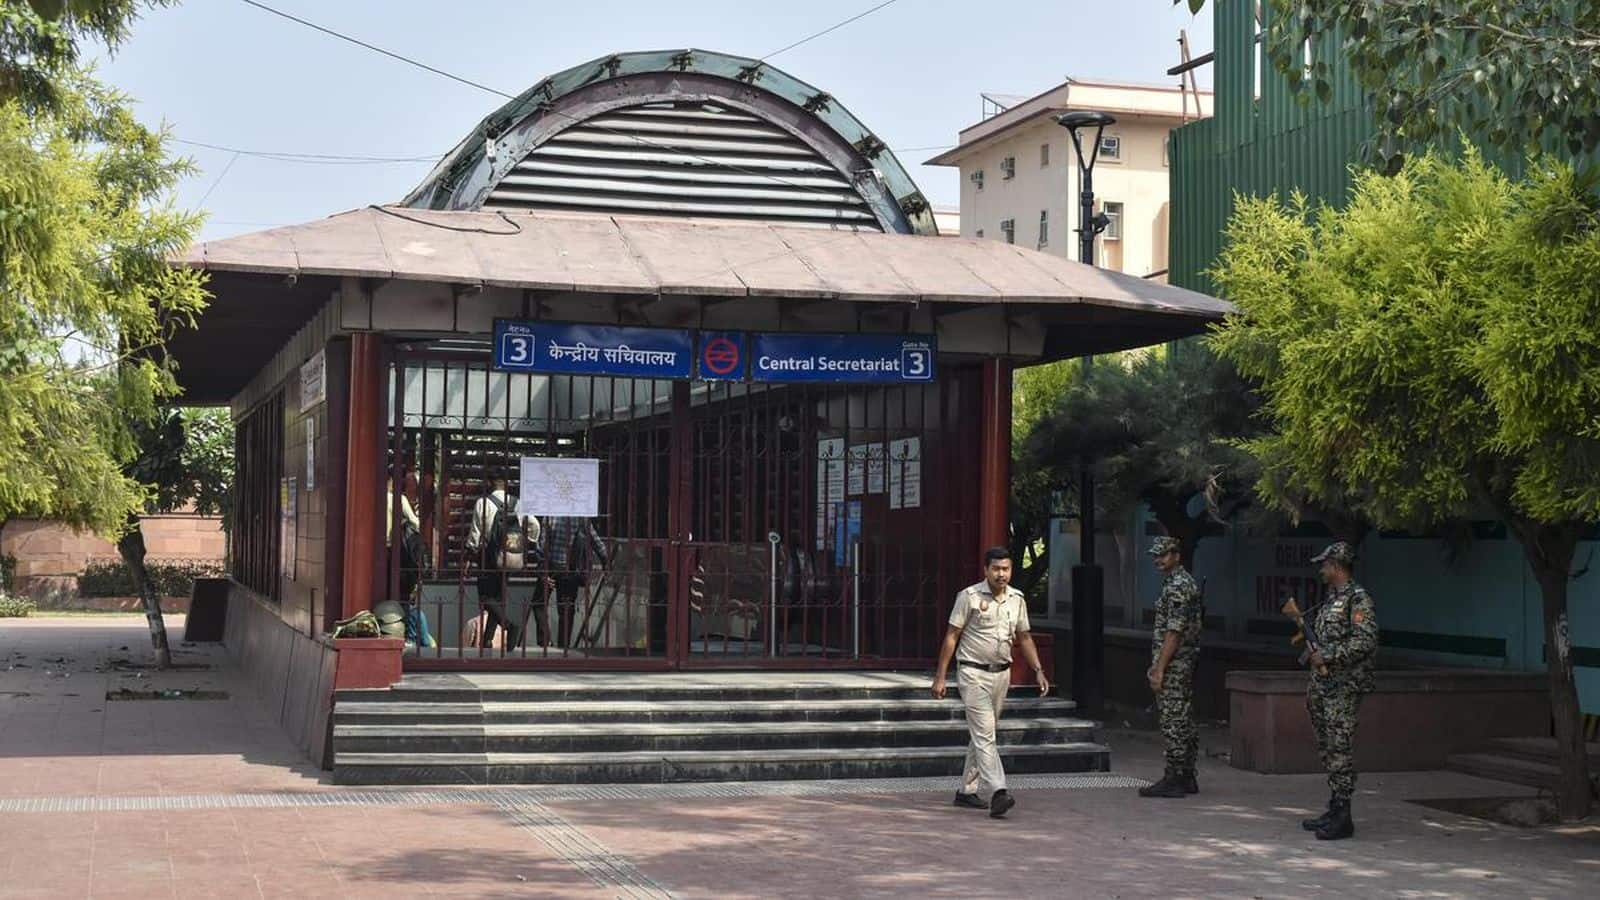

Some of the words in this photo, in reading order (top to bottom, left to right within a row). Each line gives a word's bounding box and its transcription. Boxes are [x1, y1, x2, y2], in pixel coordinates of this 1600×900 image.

[510, 338, 528, 362] 3
[549, 339, 600, 362] केन्द्रीय
[604, 344, 676, 367] सचिवालय
[759, 355, 815, 371] Central
[818, 356, 899, 373] Secretariat
[909, 351, 925, 375] 3
